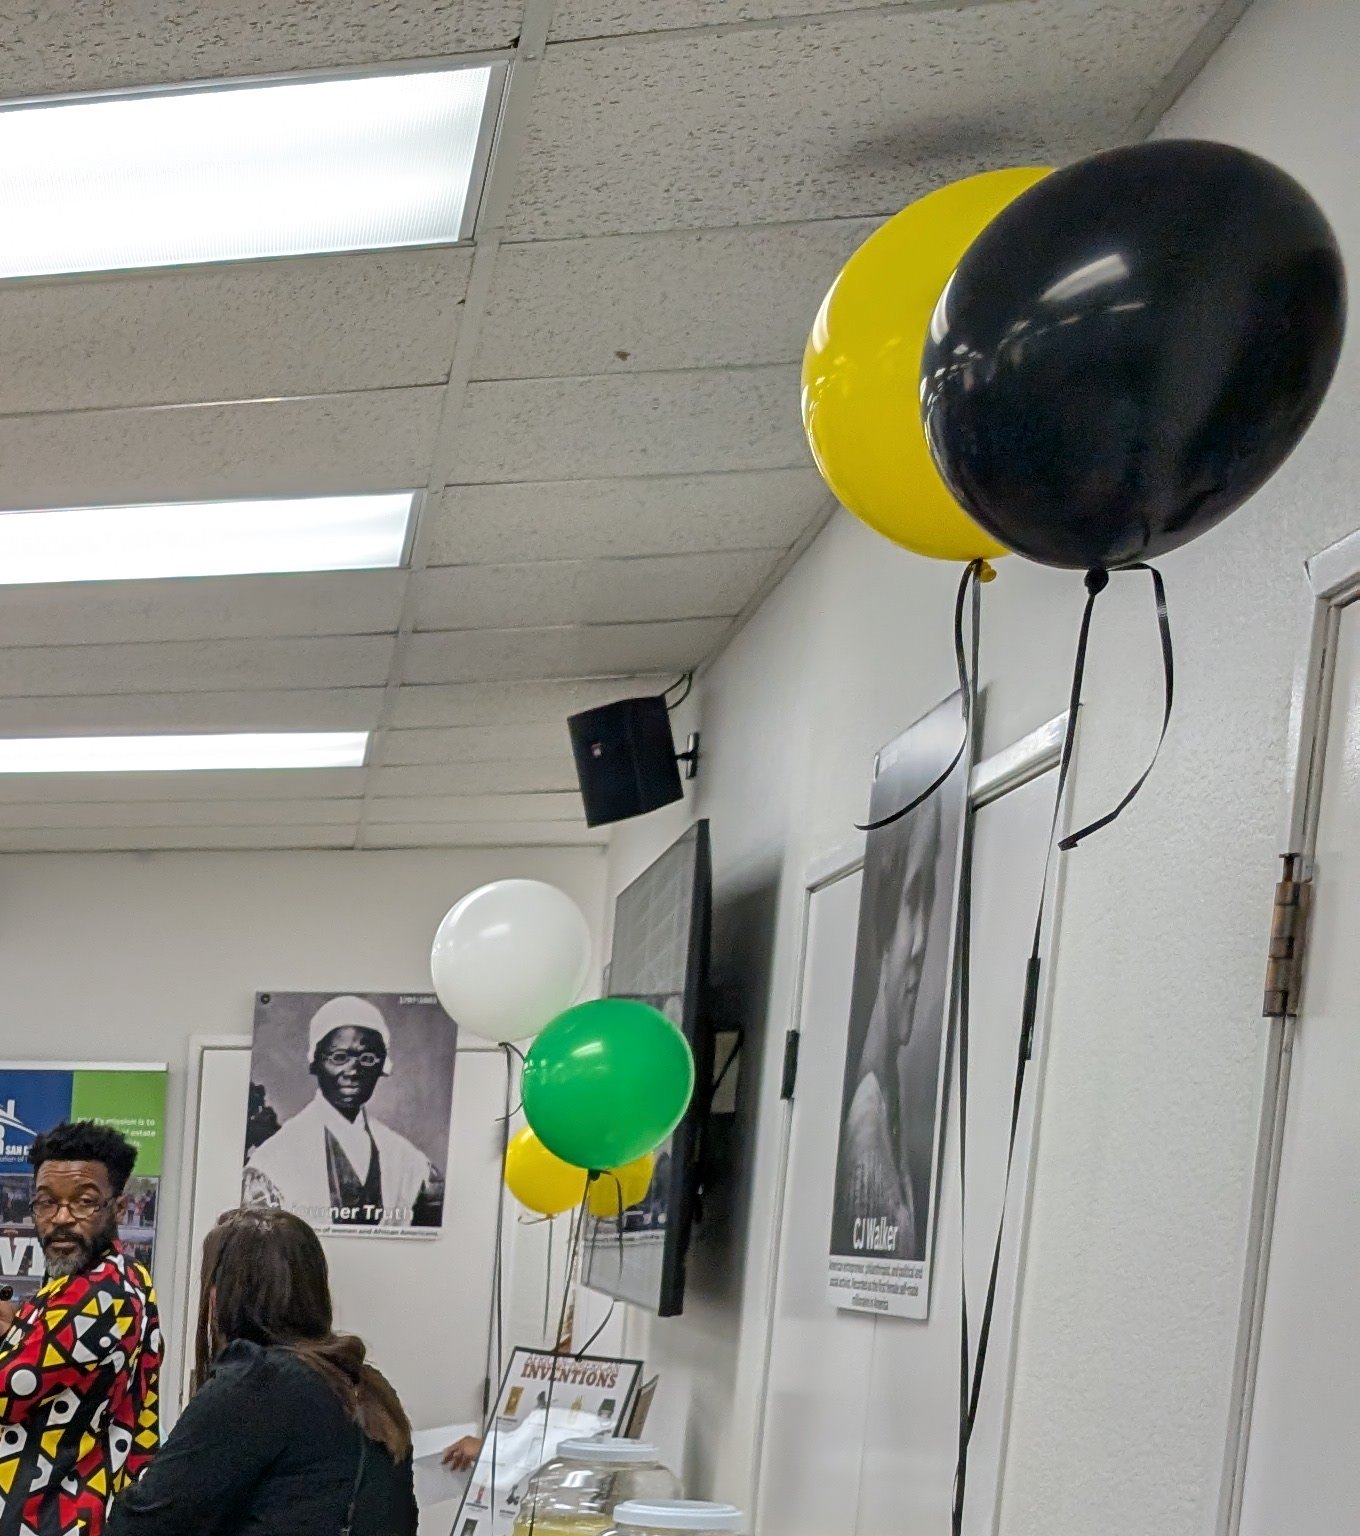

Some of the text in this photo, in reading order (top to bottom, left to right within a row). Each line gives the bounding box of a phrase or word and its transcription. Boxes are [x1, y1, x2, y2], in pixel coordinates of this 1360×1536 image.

[363, 1204, 414, 1221] Truth
[853, 1216, 899, 1251] CJ Walker
[521, 1363, 619, 1389] INVENTIONS
